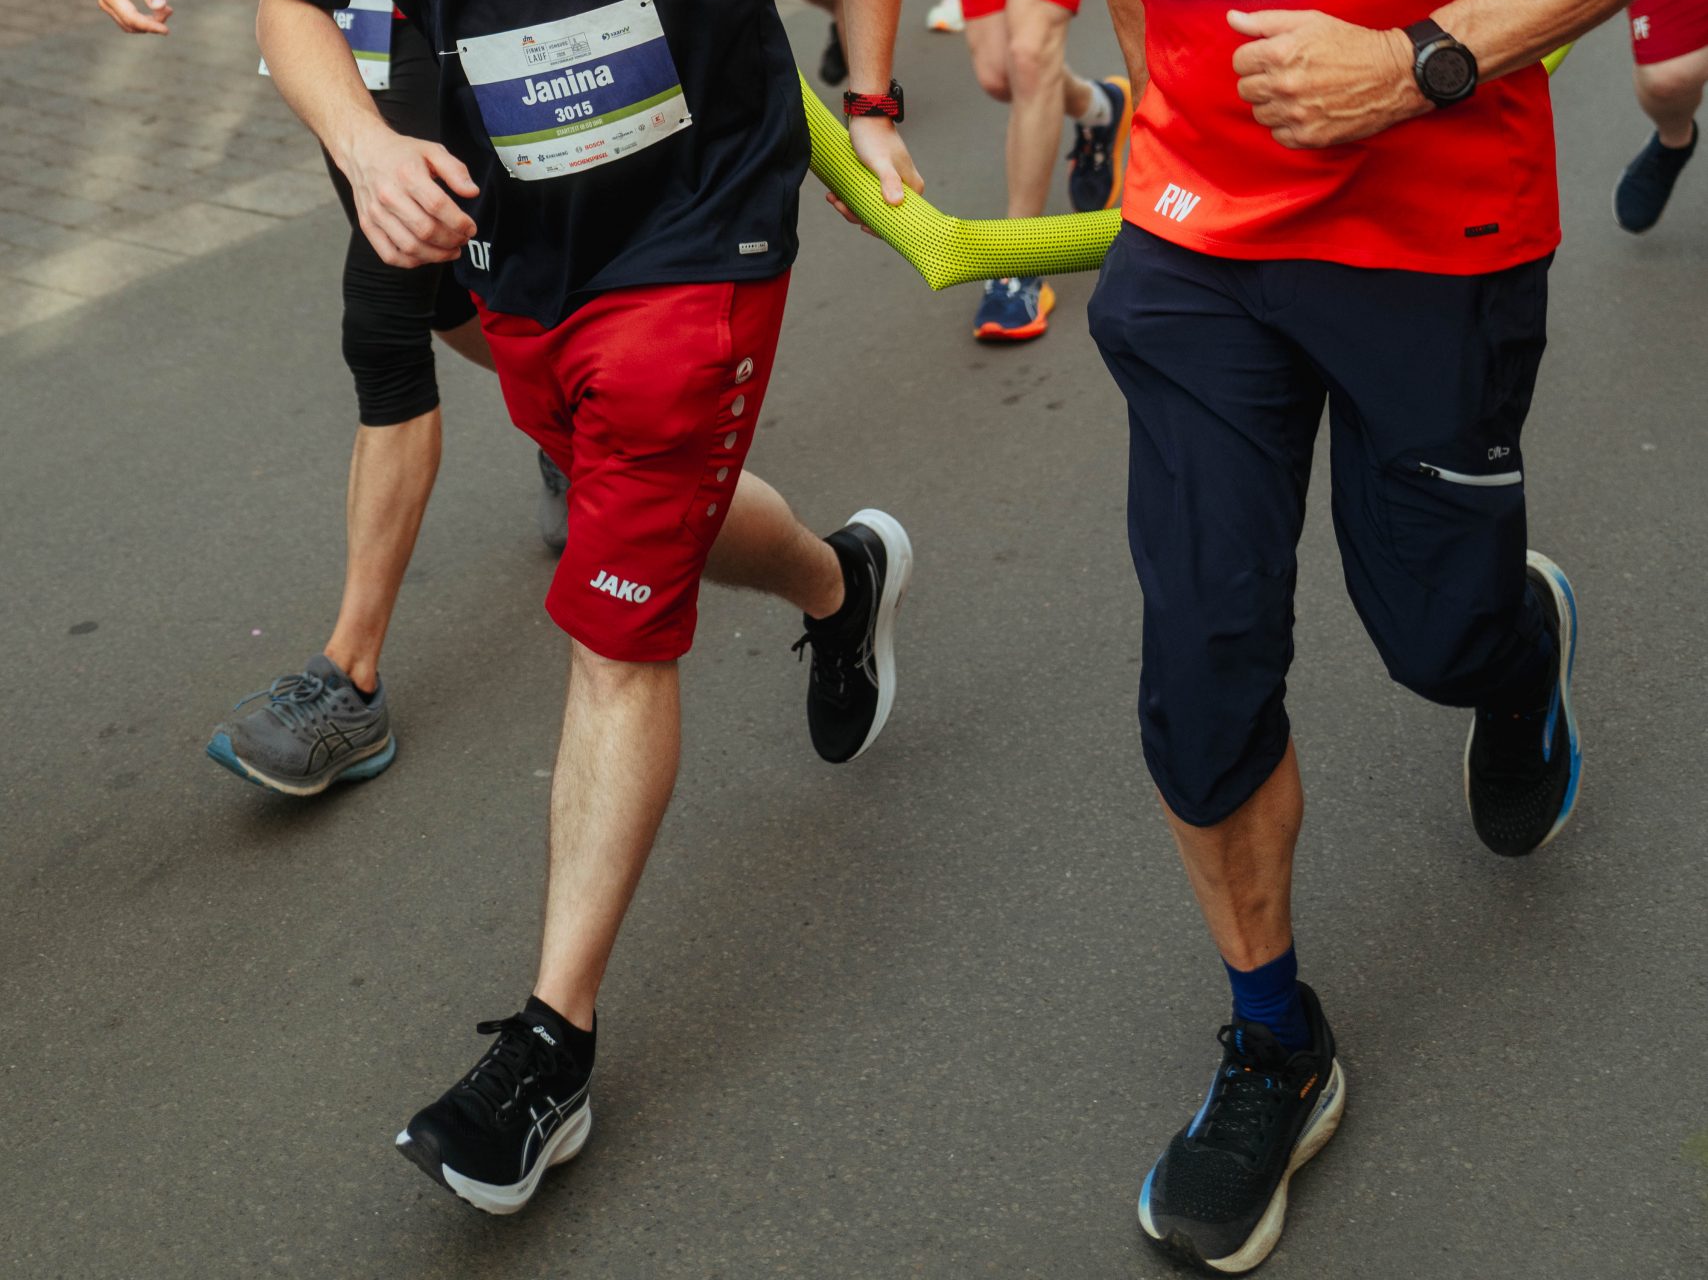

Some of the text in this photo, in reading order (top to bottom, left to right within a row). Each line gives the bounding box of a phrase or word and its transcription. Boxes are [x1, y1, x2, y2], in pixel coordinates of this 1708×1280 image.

[526, 46, 545, 55] FIRMEN
[528, 52, 547, 64] LAUF
[521, 64, 615, 105] Janina
[554, 100, 593, 123] 3015
[584, 139, 605, 151] BOSCH
[1153, 182, 1202, 223] RW
[590, 569, 652, 604] JAKO
